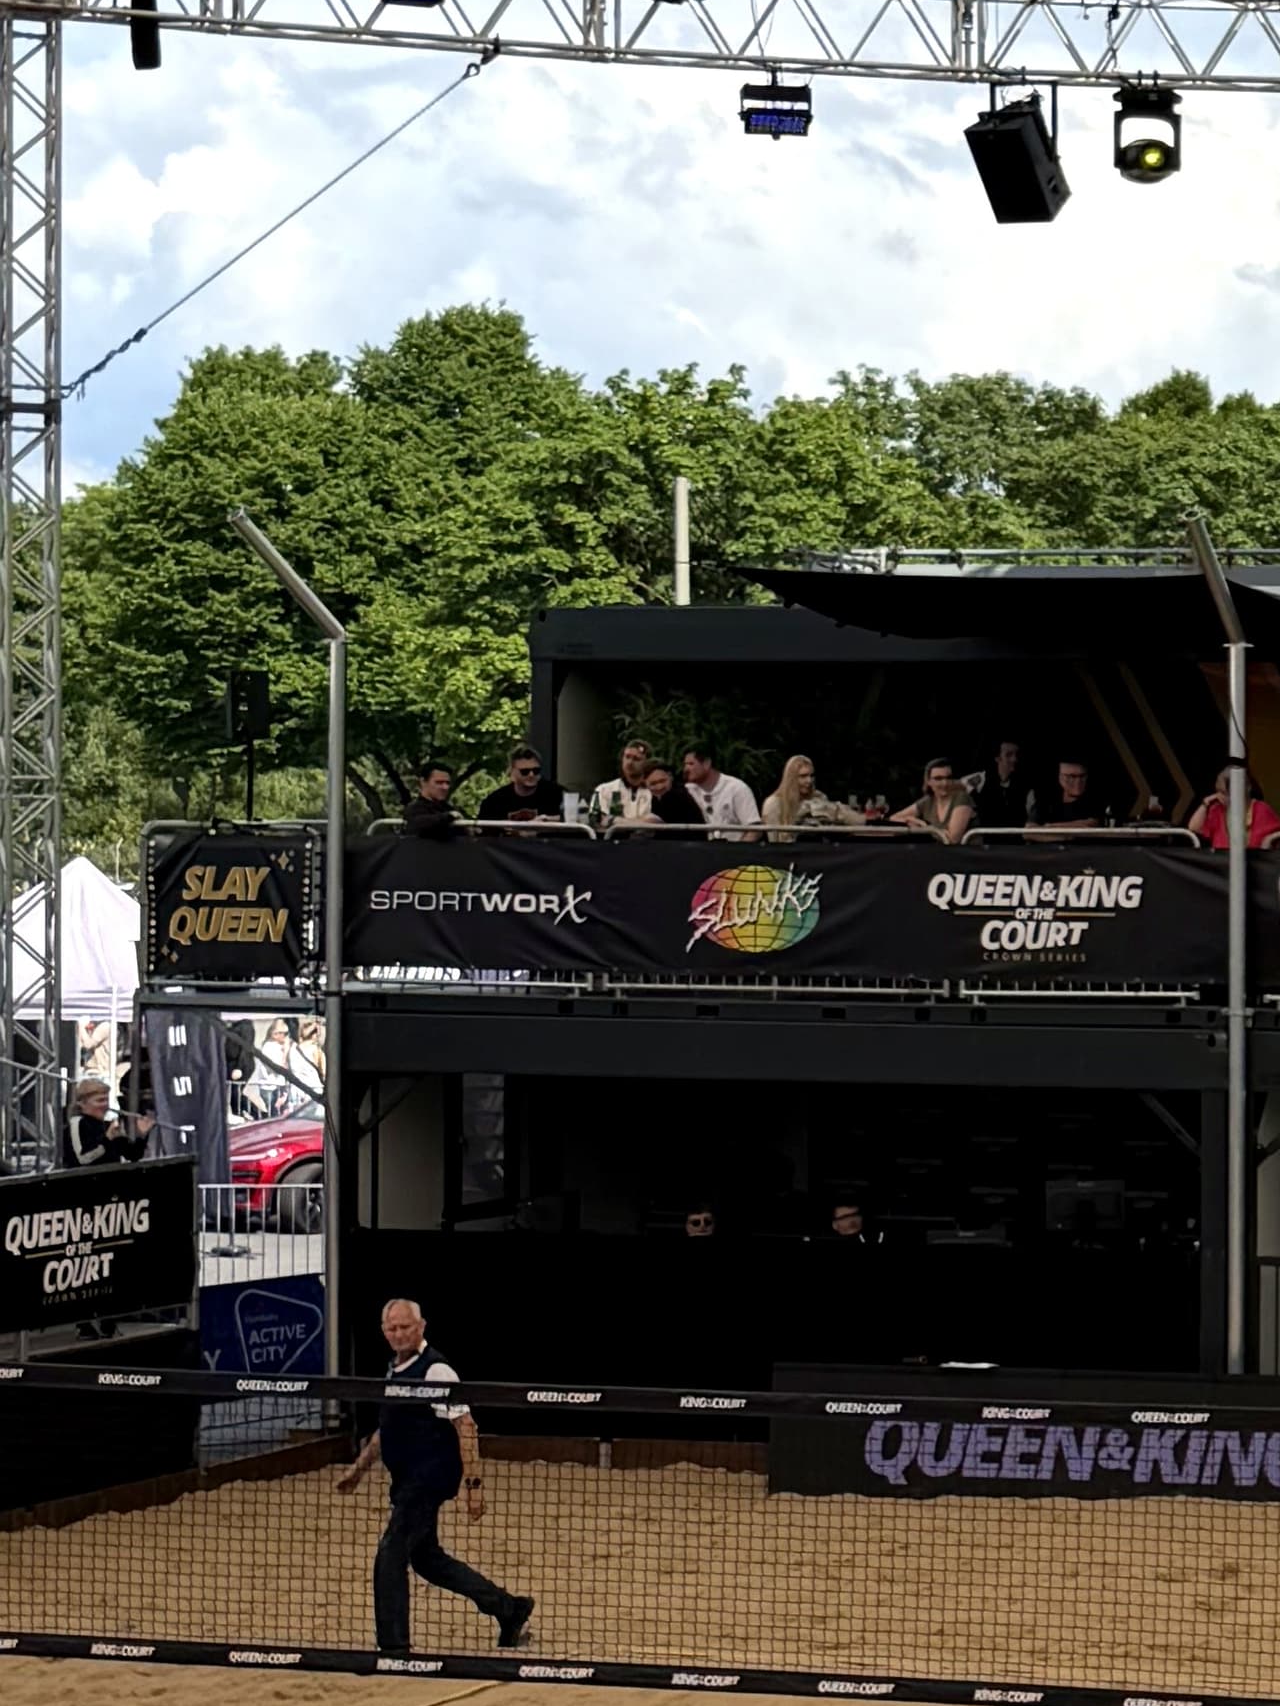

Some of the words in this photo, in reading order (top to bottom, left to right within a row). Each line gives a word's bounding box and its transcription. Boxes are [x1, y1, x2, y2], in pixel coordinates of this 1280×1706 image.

[182, 864, 270, 902] SLAY
[168, 906, 290, 945] QUEEN
[1015, 908, 1032, 920] OF
[1033, 908, 1056, 920] THE
[980, 920, 1089, 951] COURT
[43, 1253, 114, 1293] COURT
[248, 1324, 307, 1346] ACTIVE
[251, 1343, 288, 1363] CITY
